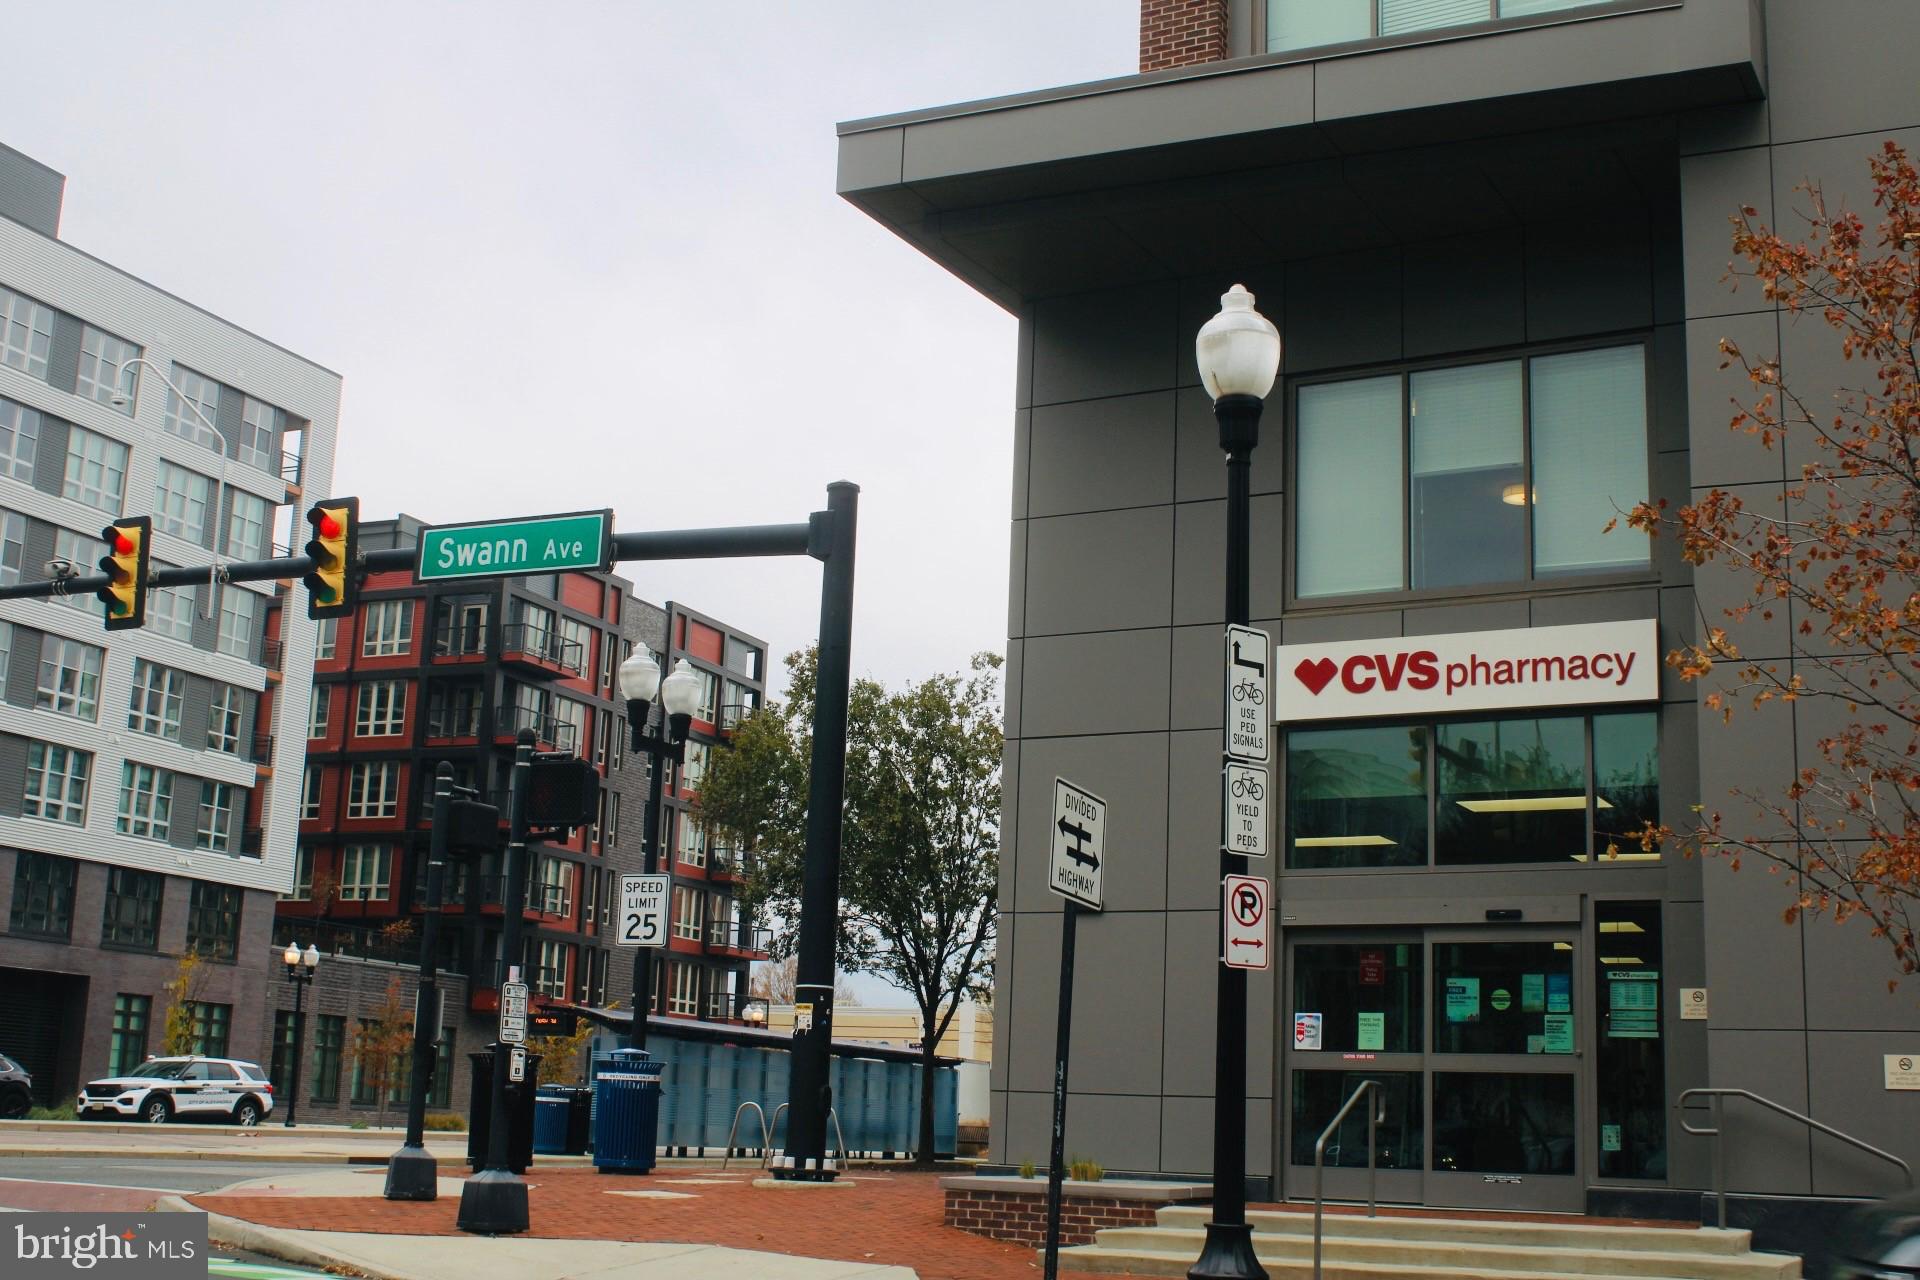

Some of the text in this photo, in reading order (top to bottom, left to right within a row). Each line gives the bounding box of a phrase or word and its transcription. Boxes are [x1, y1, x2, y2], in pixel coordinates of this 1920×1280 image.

[438, 537, 583, 569] Swann Ave
[1341, 650, 1637, 696] CVS pharmacy
[1240, 707, 1256, 720] USE
[1240, 721, 1256, 734] PED
[1232, 733, 1263, 749] SIGNALS
[1065, 793, 1097, 821] DIVIDED
[1236, 803, 1259, 817] YIELD
[1242, 819, 1253, 832] TO
[1236, 833, 1258, 848] PEDS
[625, 882, 663, 893] SPEED
[1058, 866, 1095, 895] HIGHWAY
[628, 897, 658, 909] LIMIT
[625, 913, 657, 940] 25
